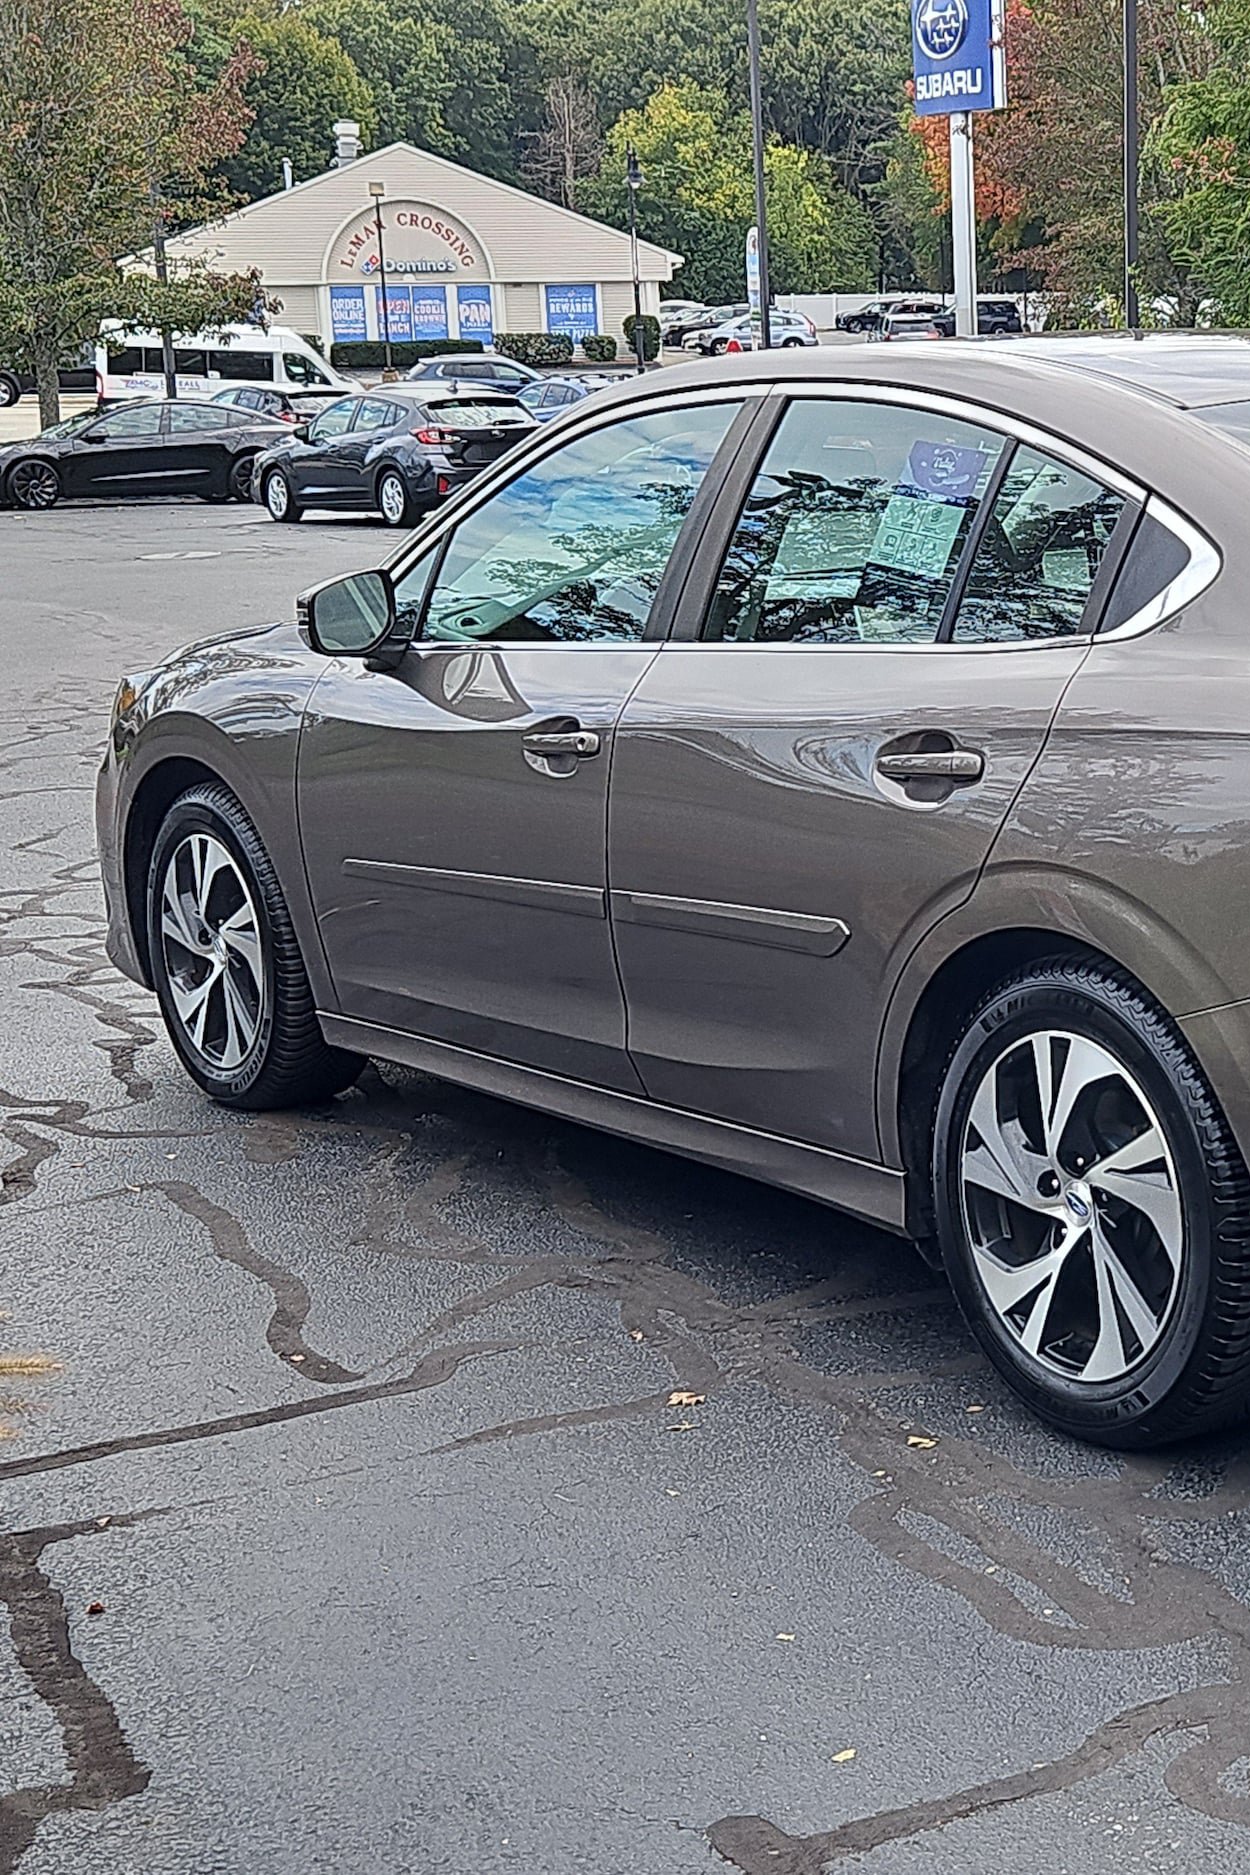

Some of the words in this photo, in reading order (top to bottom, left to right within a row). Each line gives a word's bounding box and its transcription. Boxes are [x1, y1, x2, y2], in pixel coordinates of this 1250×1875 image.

[916, 67, 982, 100] SUBARU
[396, 212, 474, 268] CROSSING
[384, 257, 457, 273] Domino's
[332, 298, 363, 310] ORDER
[549, 302, 594, 314] REWARDS
[332, 310, 365, 321] ONLINE
[459, 303, 490, 324] PAN
